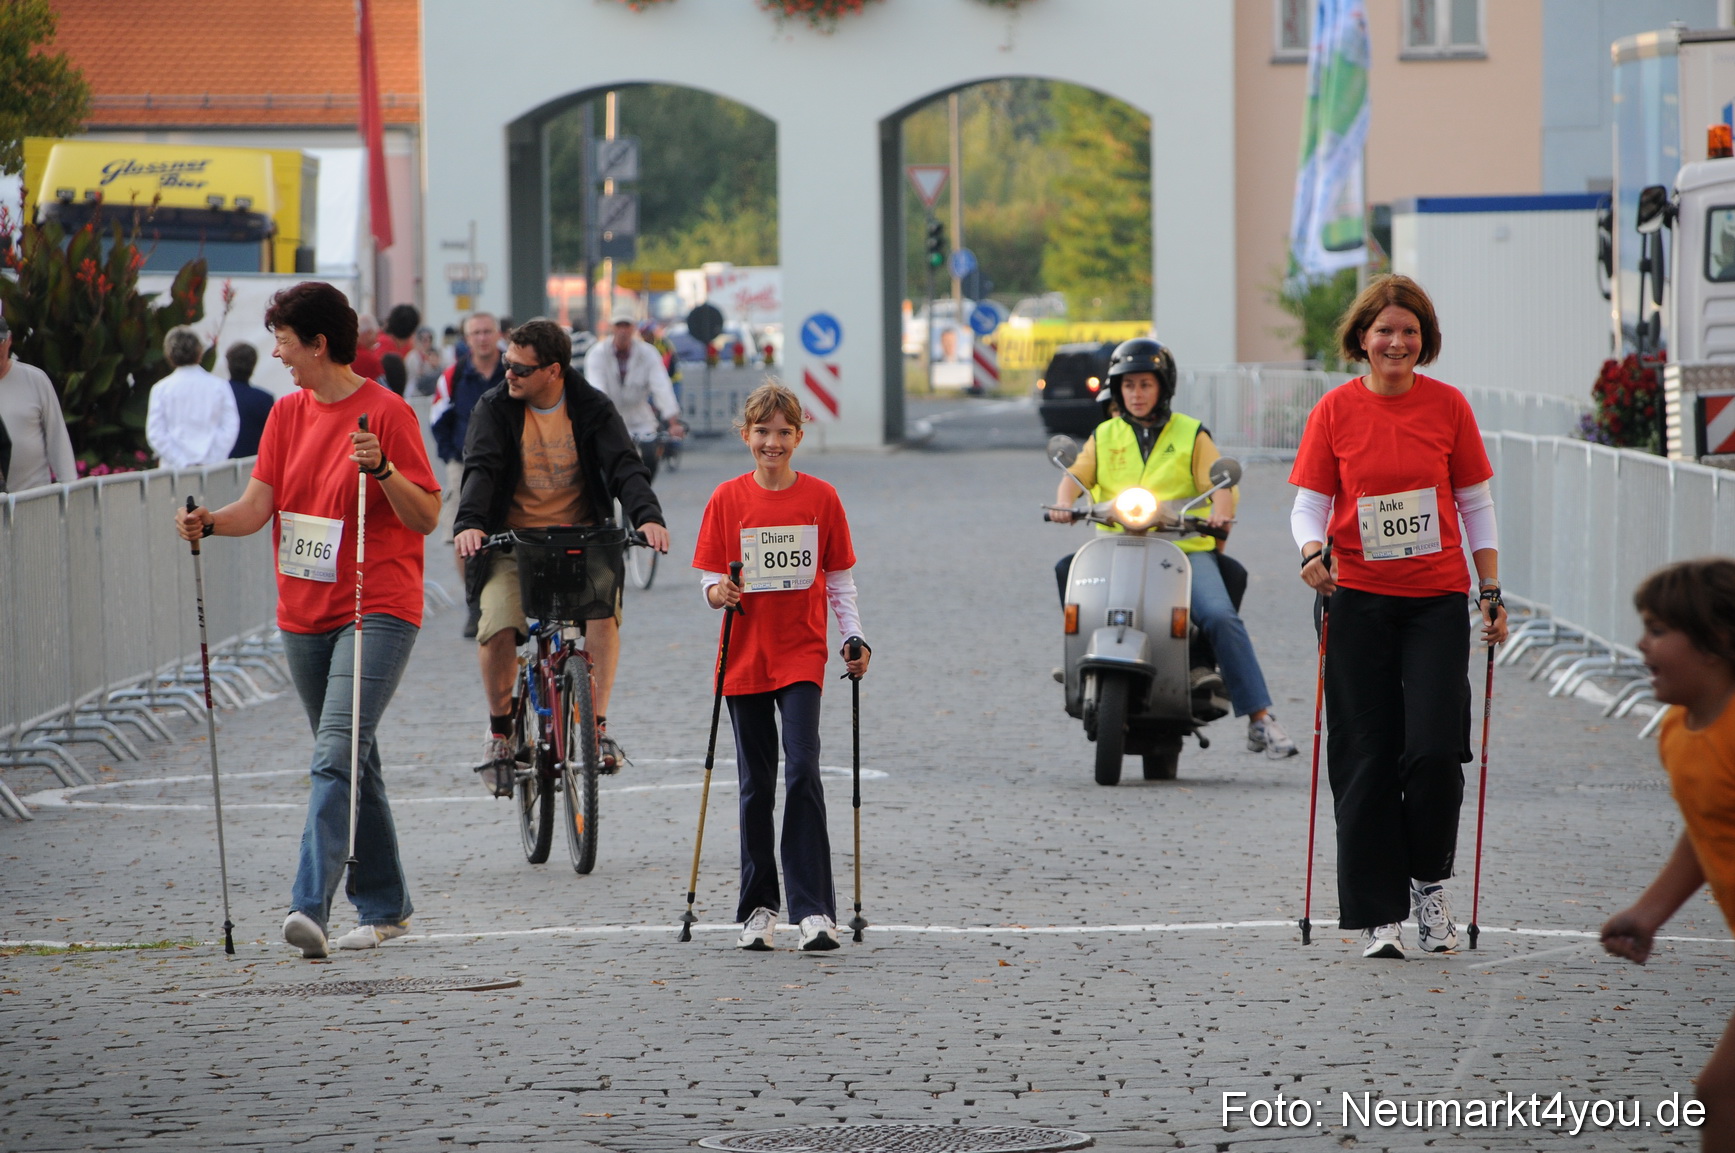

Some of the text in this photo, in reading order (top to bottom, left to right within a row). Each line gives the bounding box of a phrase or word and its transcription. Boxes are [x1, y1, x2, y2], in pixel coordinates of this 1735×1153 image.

[1380, 499, 1404, 513] Anke
[1362, 521, 1368, 530] N
[1383, 514, 1431, 537] 8057
[282, 535, 288, 544] N
[761, 532, 795, 545] Chiara
[295, 538, 333, 560] 8166
[744, 552, 750, 561] N
[764, 550, 812, 569] 8058
[196, 598, 205, 629] LEKI
